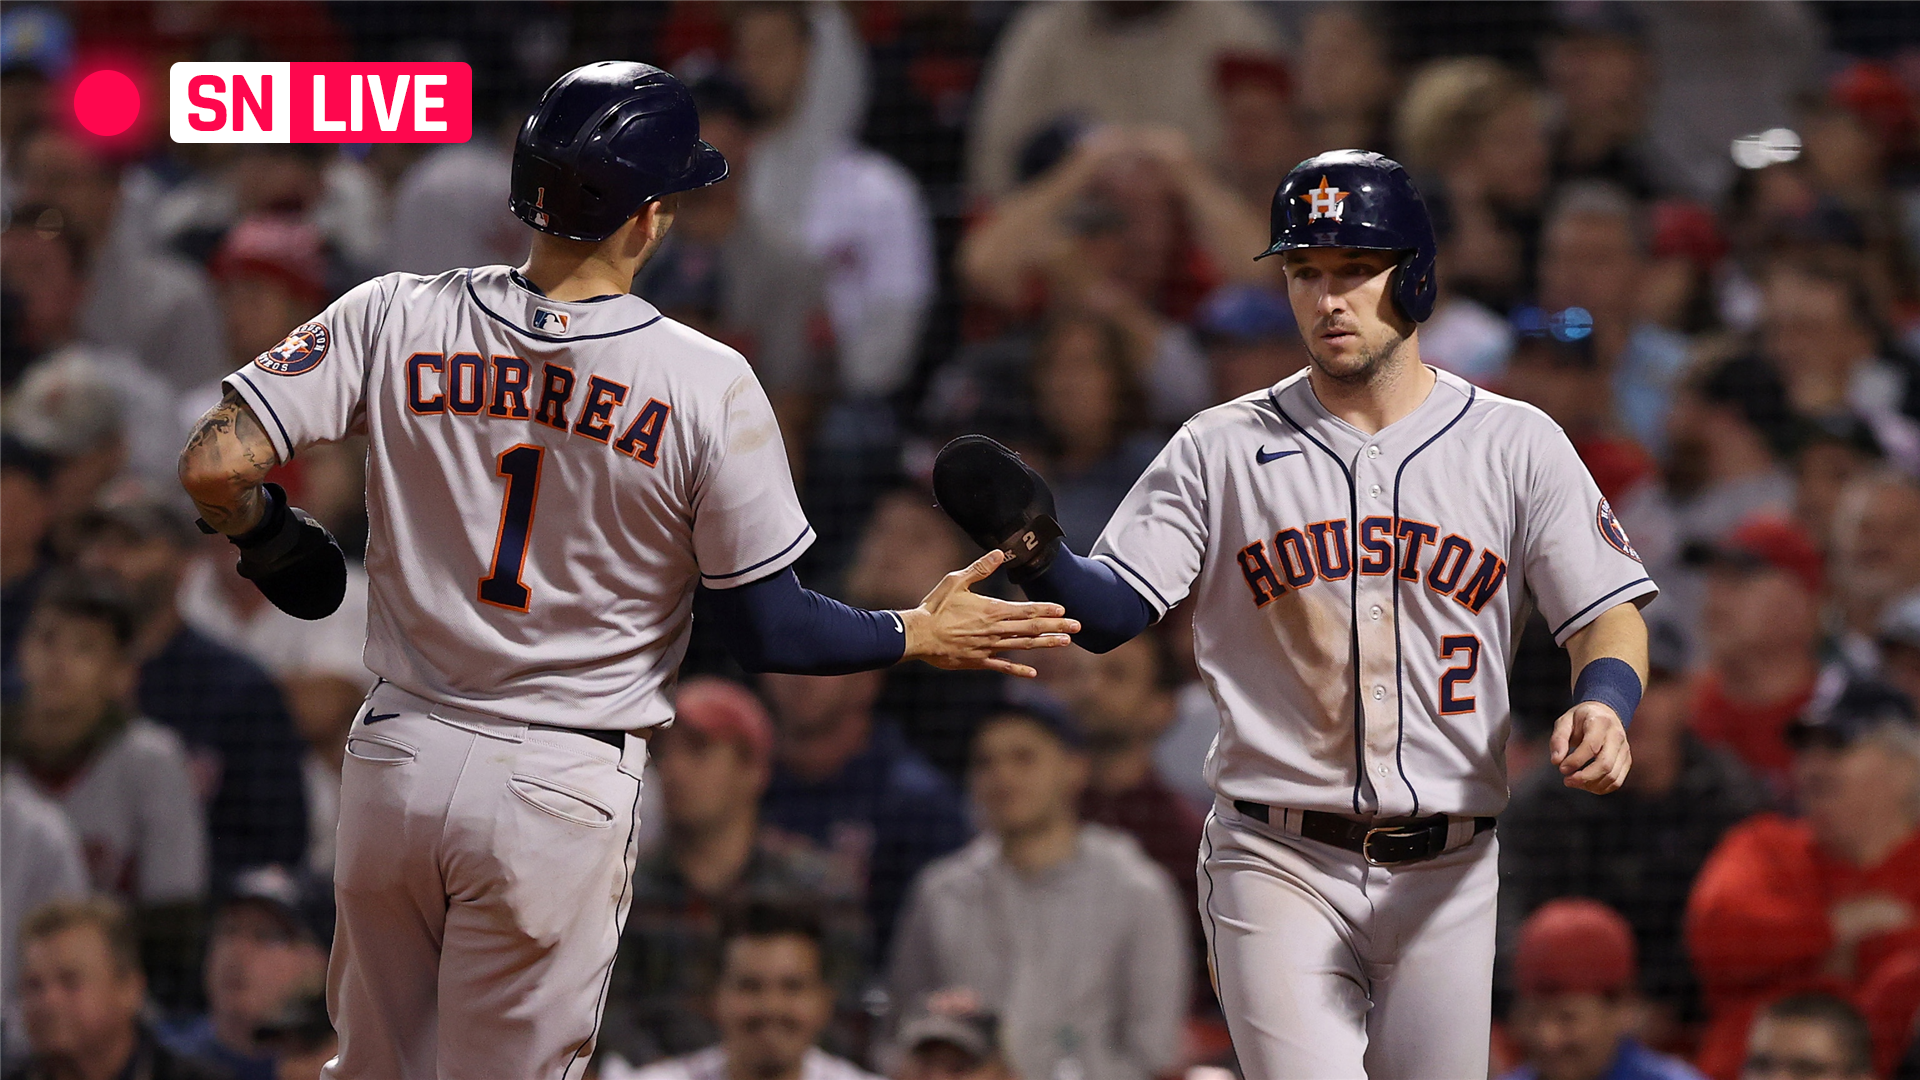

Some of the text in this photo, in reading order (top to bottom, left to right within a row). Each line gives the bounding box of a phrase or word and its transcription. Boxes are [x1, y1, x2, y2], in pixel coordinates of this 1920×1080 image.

[535, 186, 545, 209] 1
[1308, 187, 1340, 219] H
[405, 352, 672, 469] CORREA
[476, 442, 546, 614] 1
[1022, 530, 1039, 551] 2
[1236, 515, 1508, 616] HOUSTON
[1439, 634, 1482, 716] 2
